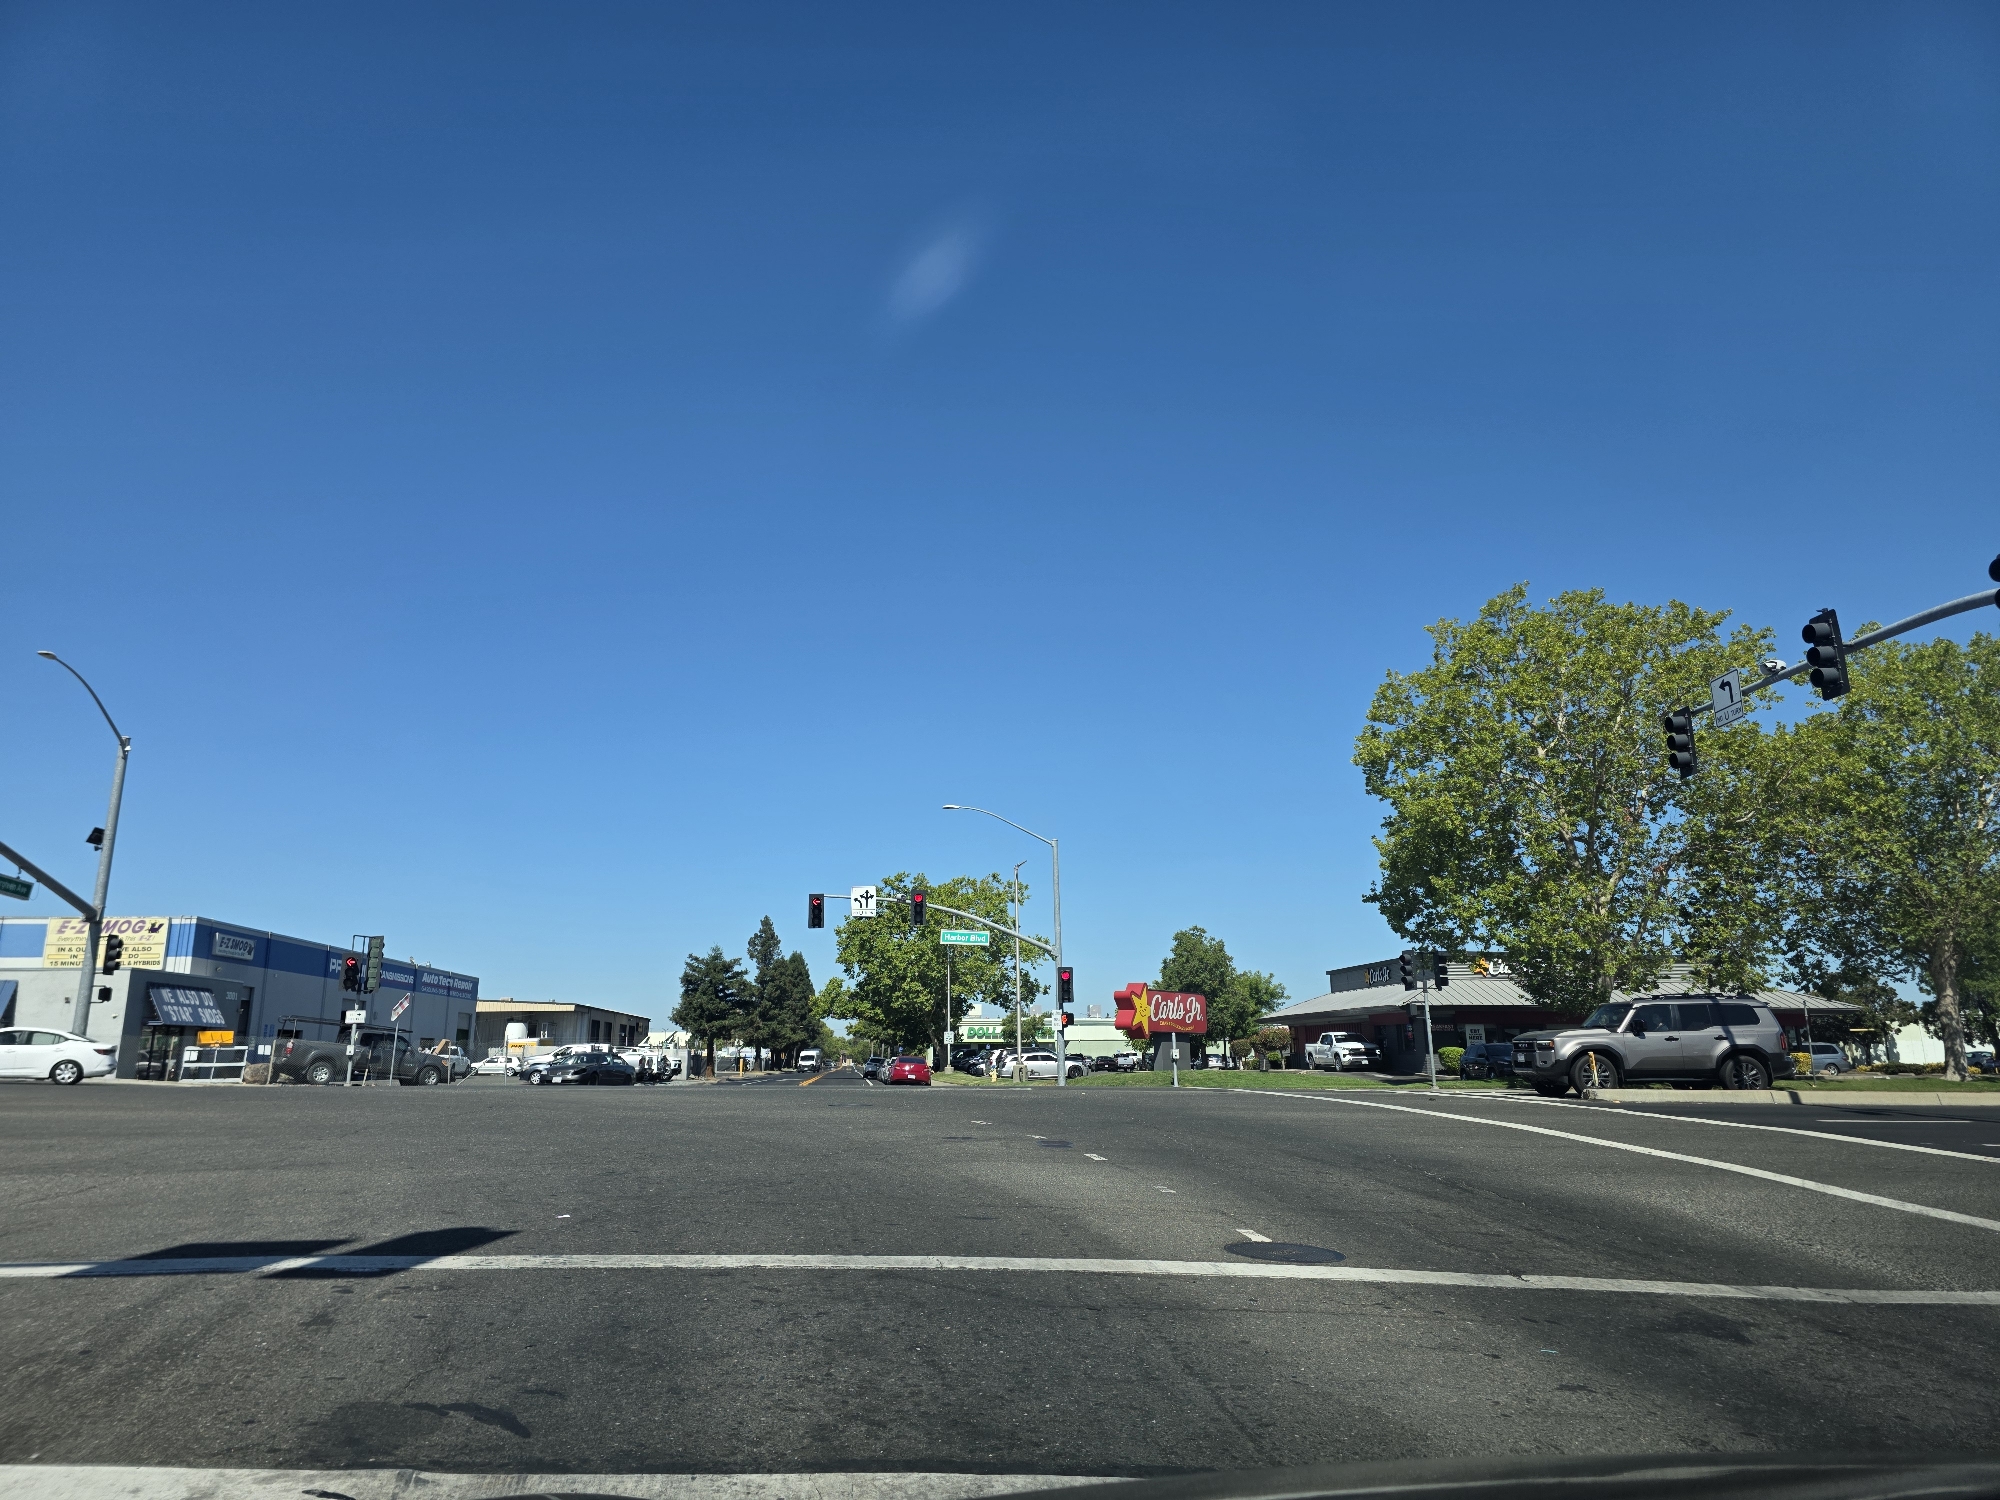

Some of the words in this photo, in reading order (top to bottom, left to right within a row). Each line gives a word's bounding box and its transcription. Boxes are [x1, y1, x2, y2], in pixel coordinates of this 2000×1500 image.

[1724, 711, 1729, 720] U
[56, 920, 89, 934] E-Z
[101, 919, 147, 934] MOG
[219, 936, 231, 948] E-Z
[230, 939, 249, 952] SMOG
[944, 933, 968, 942] Harbor
[970, 934, 986, 943] Blvd
[422, 972, 439, 986] Auto
[453, 978, 473, 991] Repair
[161, 988, 175, 1004] WE
[177, 989, 200, 1006] ALSO
[200, 991, 214, 1007] DO
[163, 1005, 194, 1022] "STAR"
[198, 1007, 226, 1025] SMOGS
[1151, 994, 1186, 1022] Carl's
